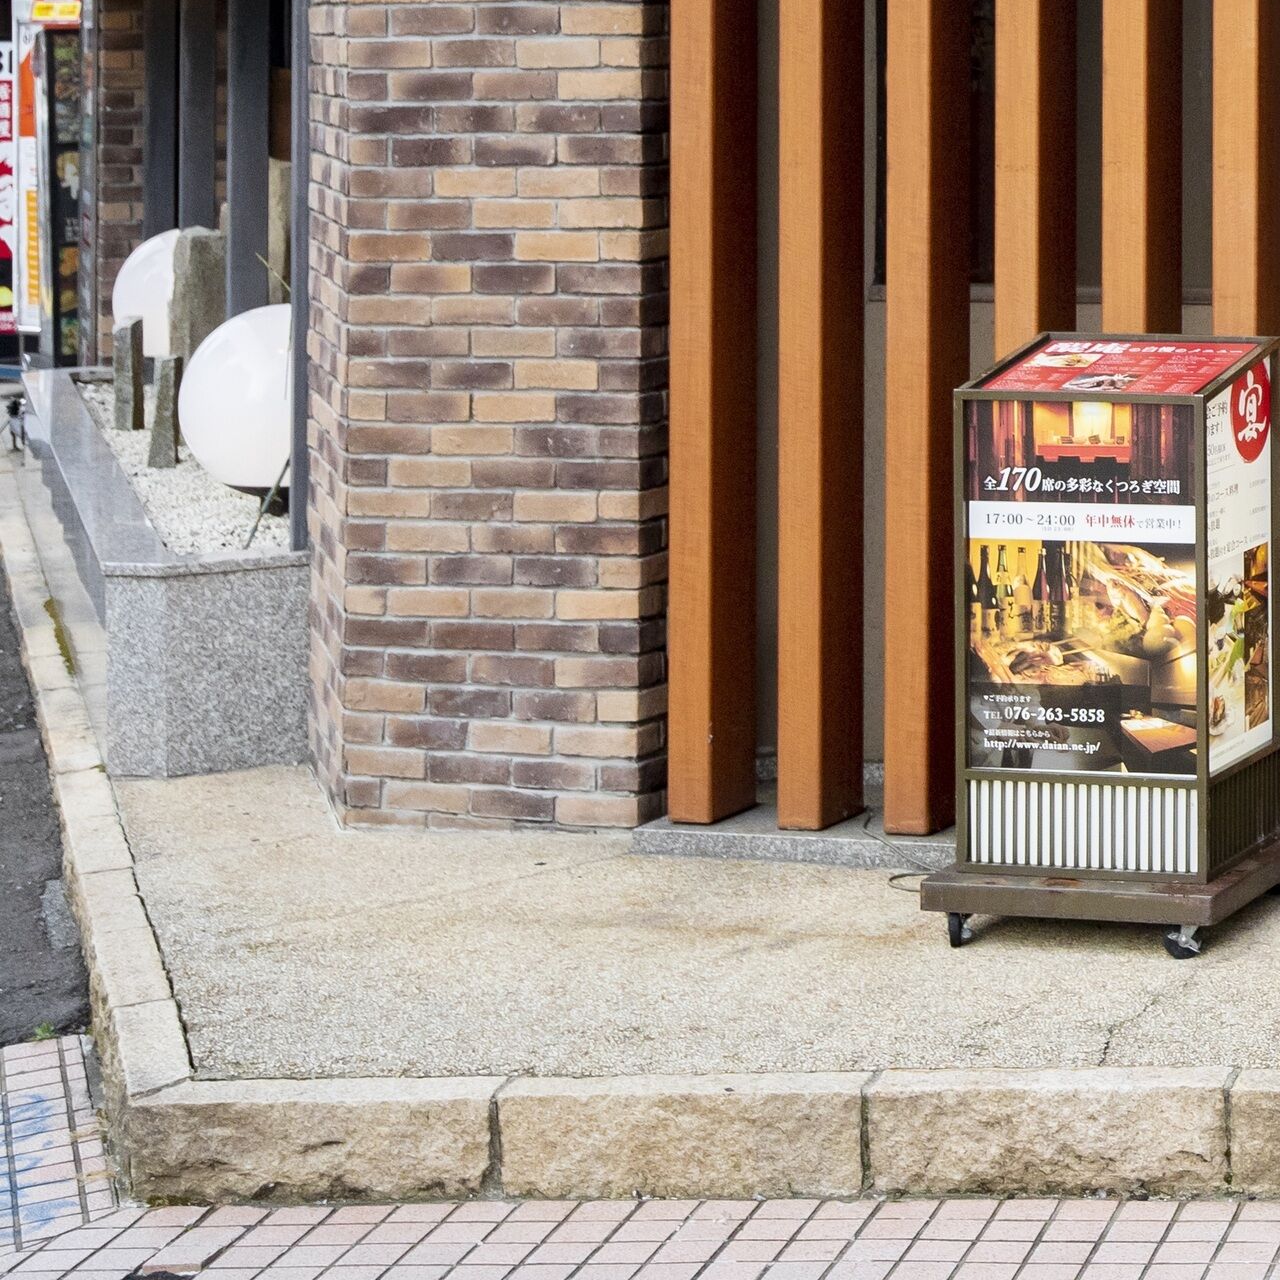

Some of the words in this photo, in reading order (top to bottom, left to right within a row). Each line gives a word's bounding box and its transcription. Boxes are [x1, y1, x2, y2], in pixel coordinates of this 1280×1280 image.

[1238, 369, 1267, 442] 宴
[984, 467, 1180, 495] 全170席の多彩なくつろぎ空間
[1085, 514, 1182, 529] 年中無休で営業中!
[983, 711, 1003, 720] TEL
[1004, 706, 1105, 723] 076-263-5858
[984, 738, 1101, 754] http://www.daian.ne.jp/
